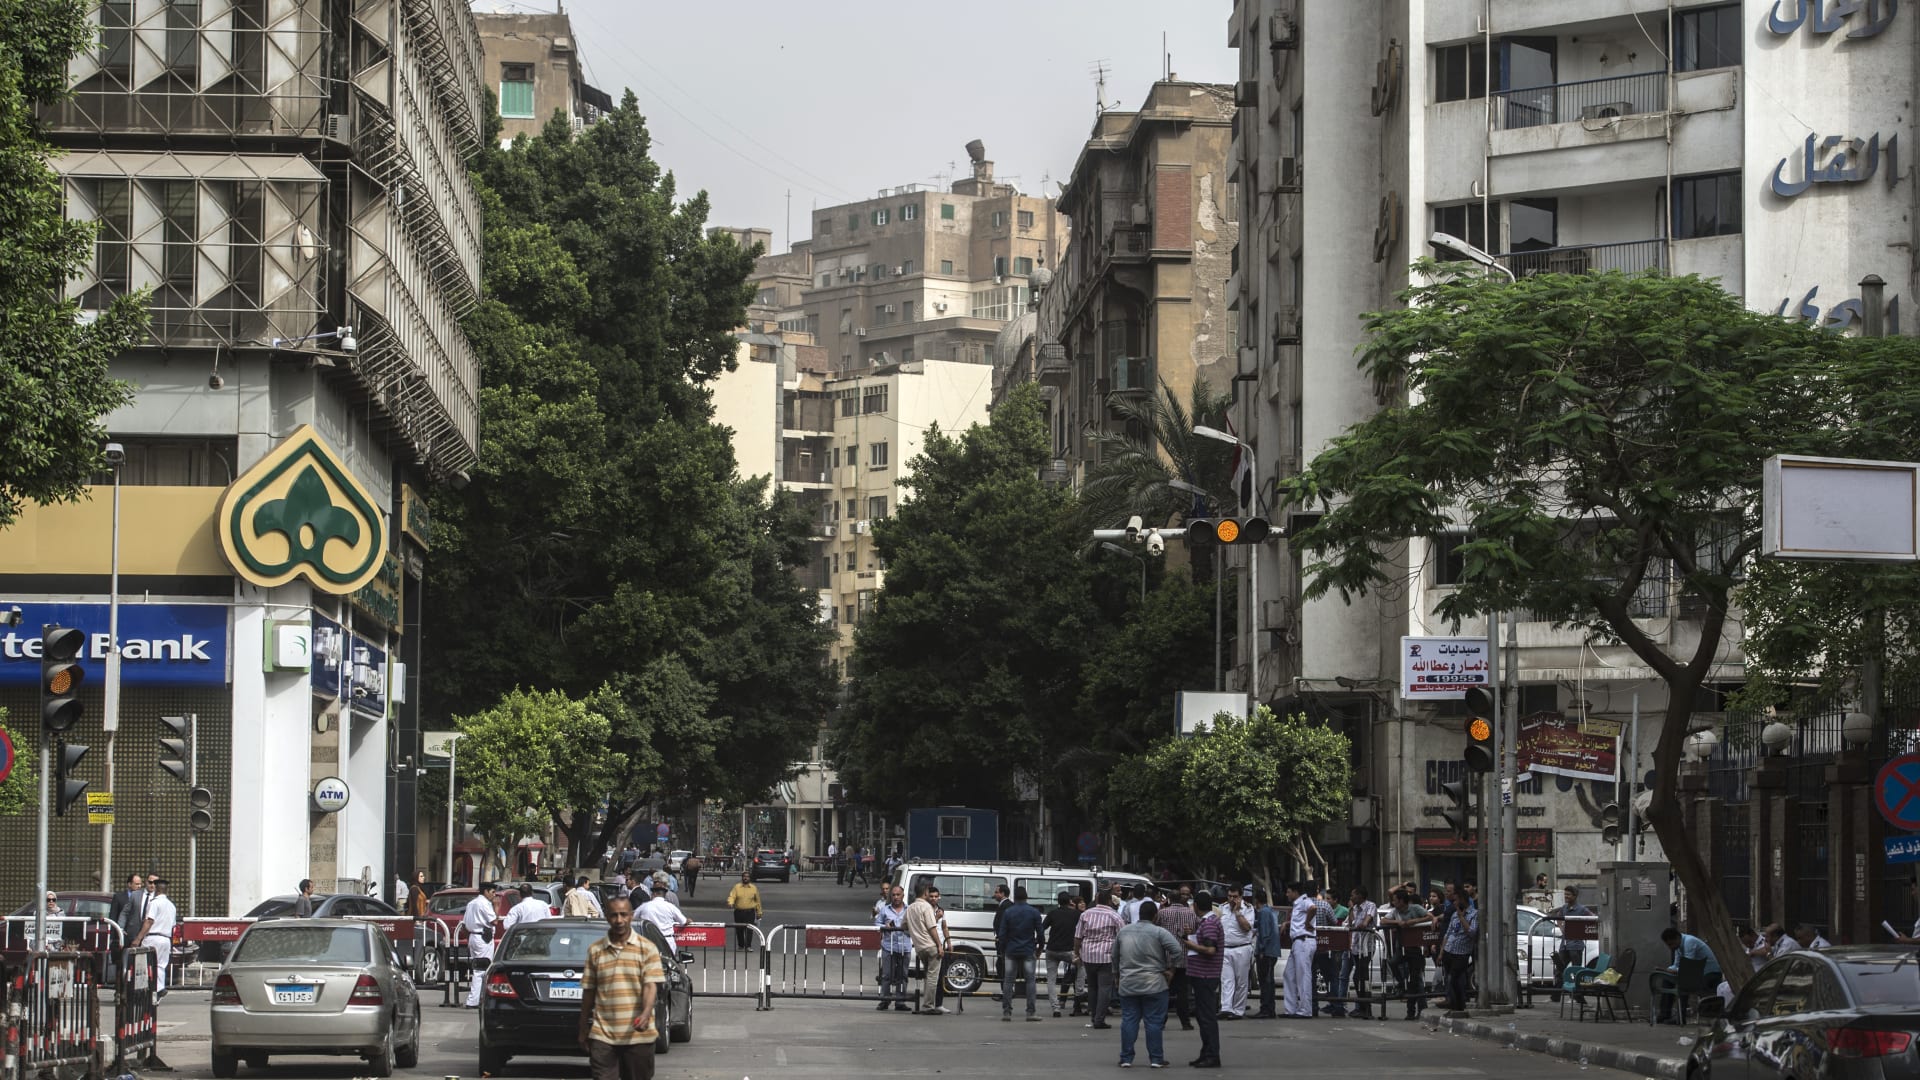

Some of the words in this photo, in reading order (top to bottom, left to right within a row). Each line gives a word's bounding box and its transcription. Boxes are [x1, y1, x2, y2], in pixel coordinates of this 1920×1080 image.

[1772, 132, 1898, 197] النقل
[1, 632, 84, 659] te
[91, 633, 212, 660] Bank
[1438, 644, 1481, 657] صيدليات
[1433, 674, 1477, 683] 19955
[320, 790, 344, 799] ATM
[1517, 806, 1546, 817] AGENCY
